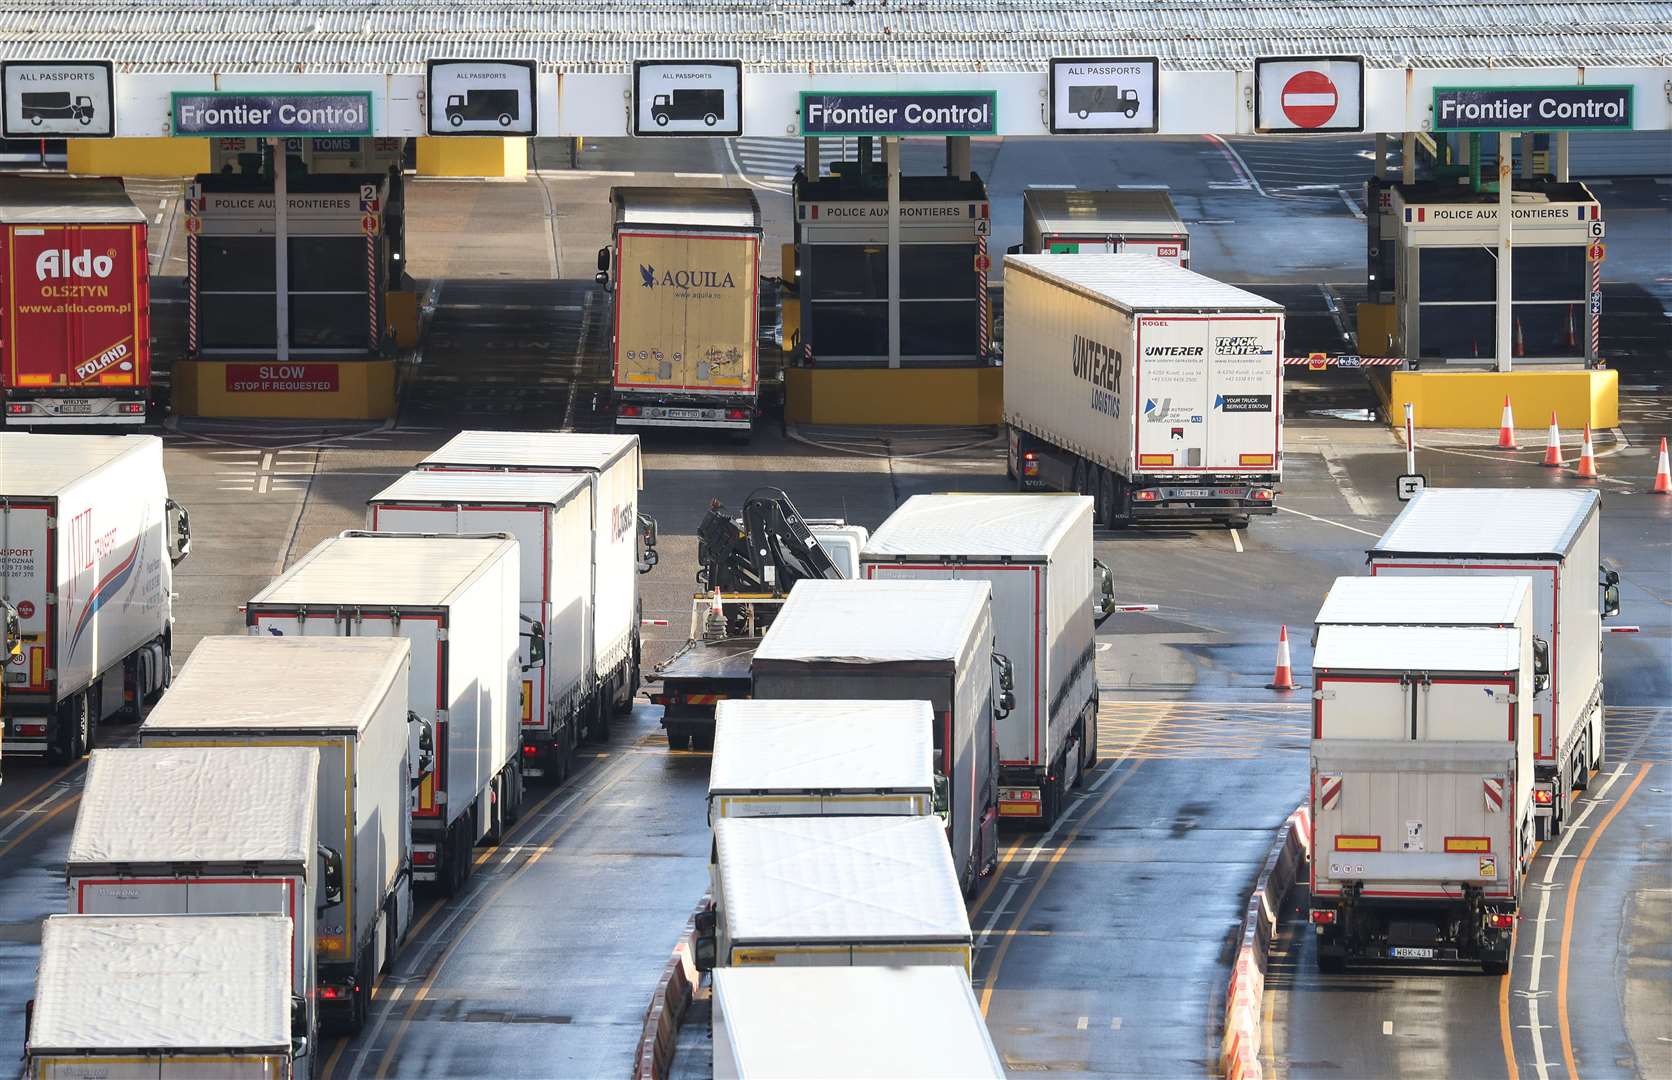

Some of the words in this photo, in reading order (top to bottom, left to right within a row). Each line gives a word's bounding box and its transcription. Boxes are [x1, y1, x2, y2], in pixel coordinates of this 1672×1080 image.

[20, 73, 37, 81] ALL
[39, 72, 95, 81] PASSPORTS
[1068, 67, 1085, 75] ALL
[1087, 66, 1141, 75] PASSPORTS
[181, 104, 272, 126] Frontier
[278, 103, 364, 125] Control
[808, 102, 898, 124] Frontier
[904, 101, 988, 124] Control
[1442, 98, 1532, 119] Frontier
[1538, 98, 1624, 119] Control
[364, 186, 373, 199] 2
[215, 199, 255, 209] POLICE
[827, 208, 866, 217] POLICE
[869, 208, 890, 217] AUX
[899, 207, 960, 216] RONTIERES
[1434, 210, 1473, 219] POLICE
[1476, 210, 1498, 219] AUX
[1511, 209, 1569, 218] ONTIERES
[977, 221, 987, 234] 4
[1592, 223, 1602, 236] 6
[36, 248, 113, 281] Aldo
[662, 270, 736, 289] AQUILA
[41, 285, 109, 298] OLSZTYN
[19, 303, 131, 314] www.aldo.com.pl
[1215, 337, 1258, 347] TRUCK
[1145, 346, 1204, 356] UNTERER
[1215, 345, 1264, 355] CENTER
[76, 344, 127, 379] POLAND
[1073, 334, 1122, 394] UNTERER
[259, 366, 305, 379] SLOW
[234, 382, 260, 390] STOP
[262, 382, 270, 390] IF
[272, 382, 331, 390] REQUESTED
[1091, 387, 1121, 420] LOGISTICS
